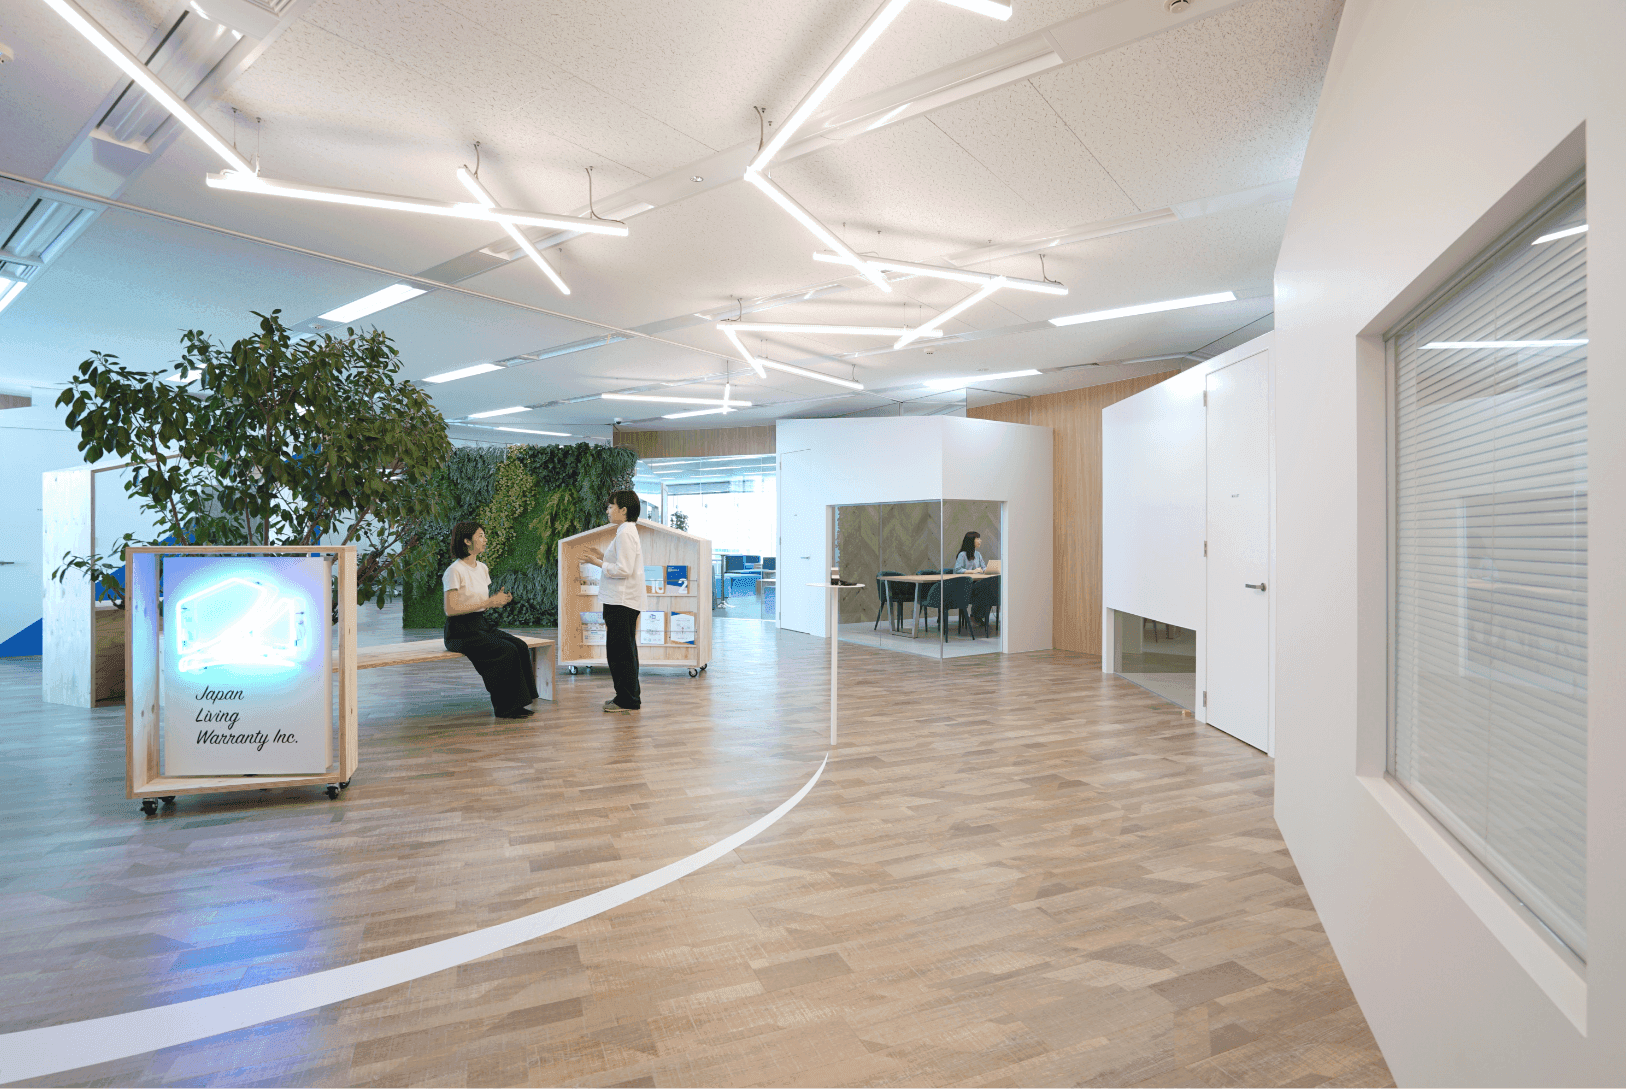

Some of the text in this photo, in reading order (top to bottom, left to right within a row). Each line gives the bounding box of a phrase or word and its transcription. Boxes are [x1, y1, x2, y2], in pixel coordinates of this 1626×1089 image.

[195, 685, 244, 705] Japan
[195, 707, 240, 730] Living
[196, 728, 298, 752] Warranty Inc.
